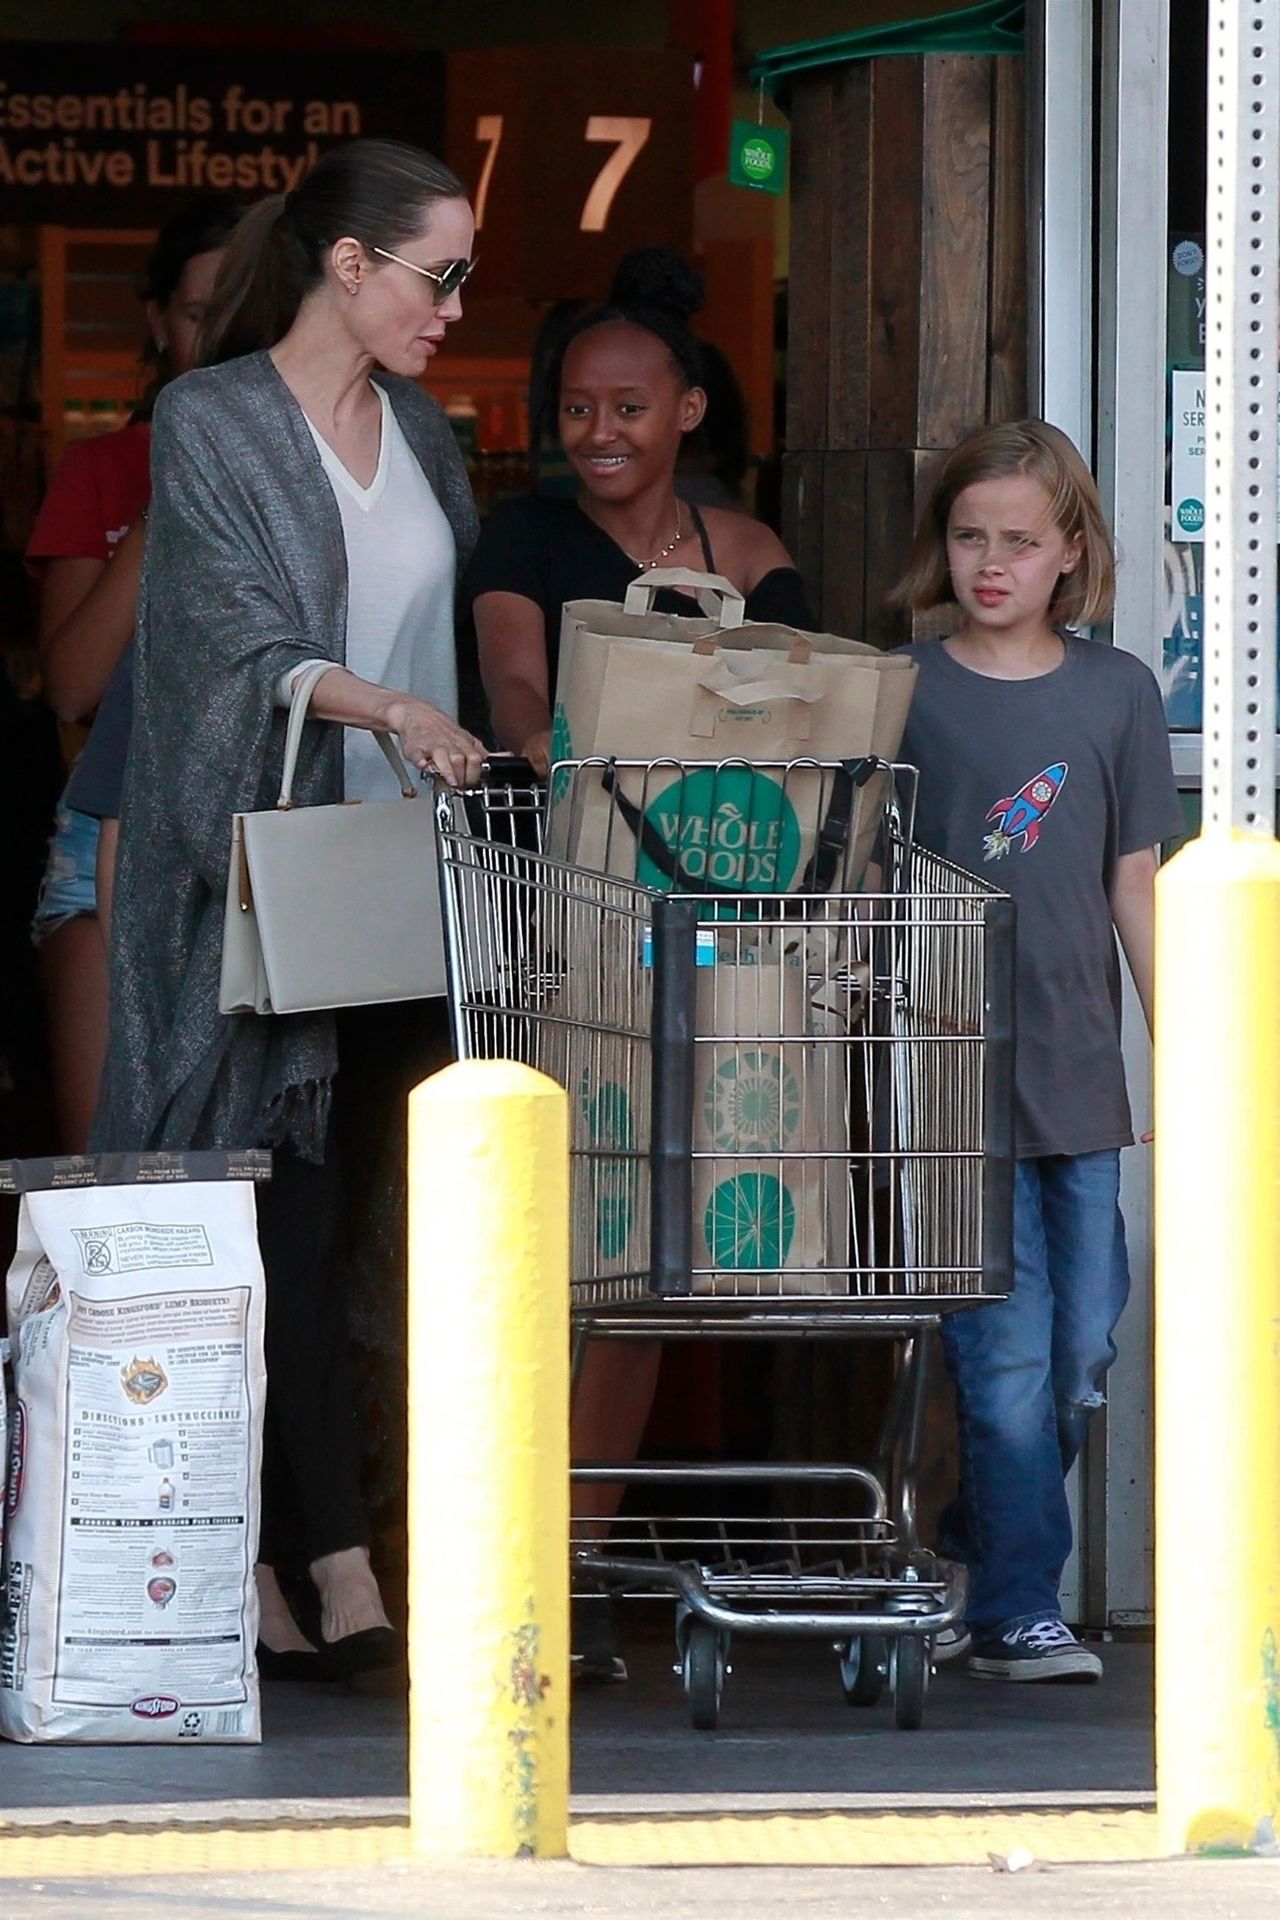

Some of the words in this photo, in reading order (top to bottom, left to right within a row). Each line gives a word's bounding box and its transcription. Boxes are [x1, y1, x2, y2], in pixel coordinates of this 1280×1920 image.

[0, 81, 213, 131] ssentials
[222, 85, 293, 134] for
[304, 100, 361, 135] an
[147, 139, 319, 194] Lifestyl
[580, 117, 652, 232] 7
[1183, 411, 1205, 426] SER
[658, 803, 785, 849] WHOLE
[669, 846, 782, 883] OODS
[116, 1226, 143, 1235] CARBON
[88, 1307, 115, 1317] CHOOSE
[164, 1300, 188, 1309] LUMP
[82, 1410, 144, 1427] DIRECTIONS
